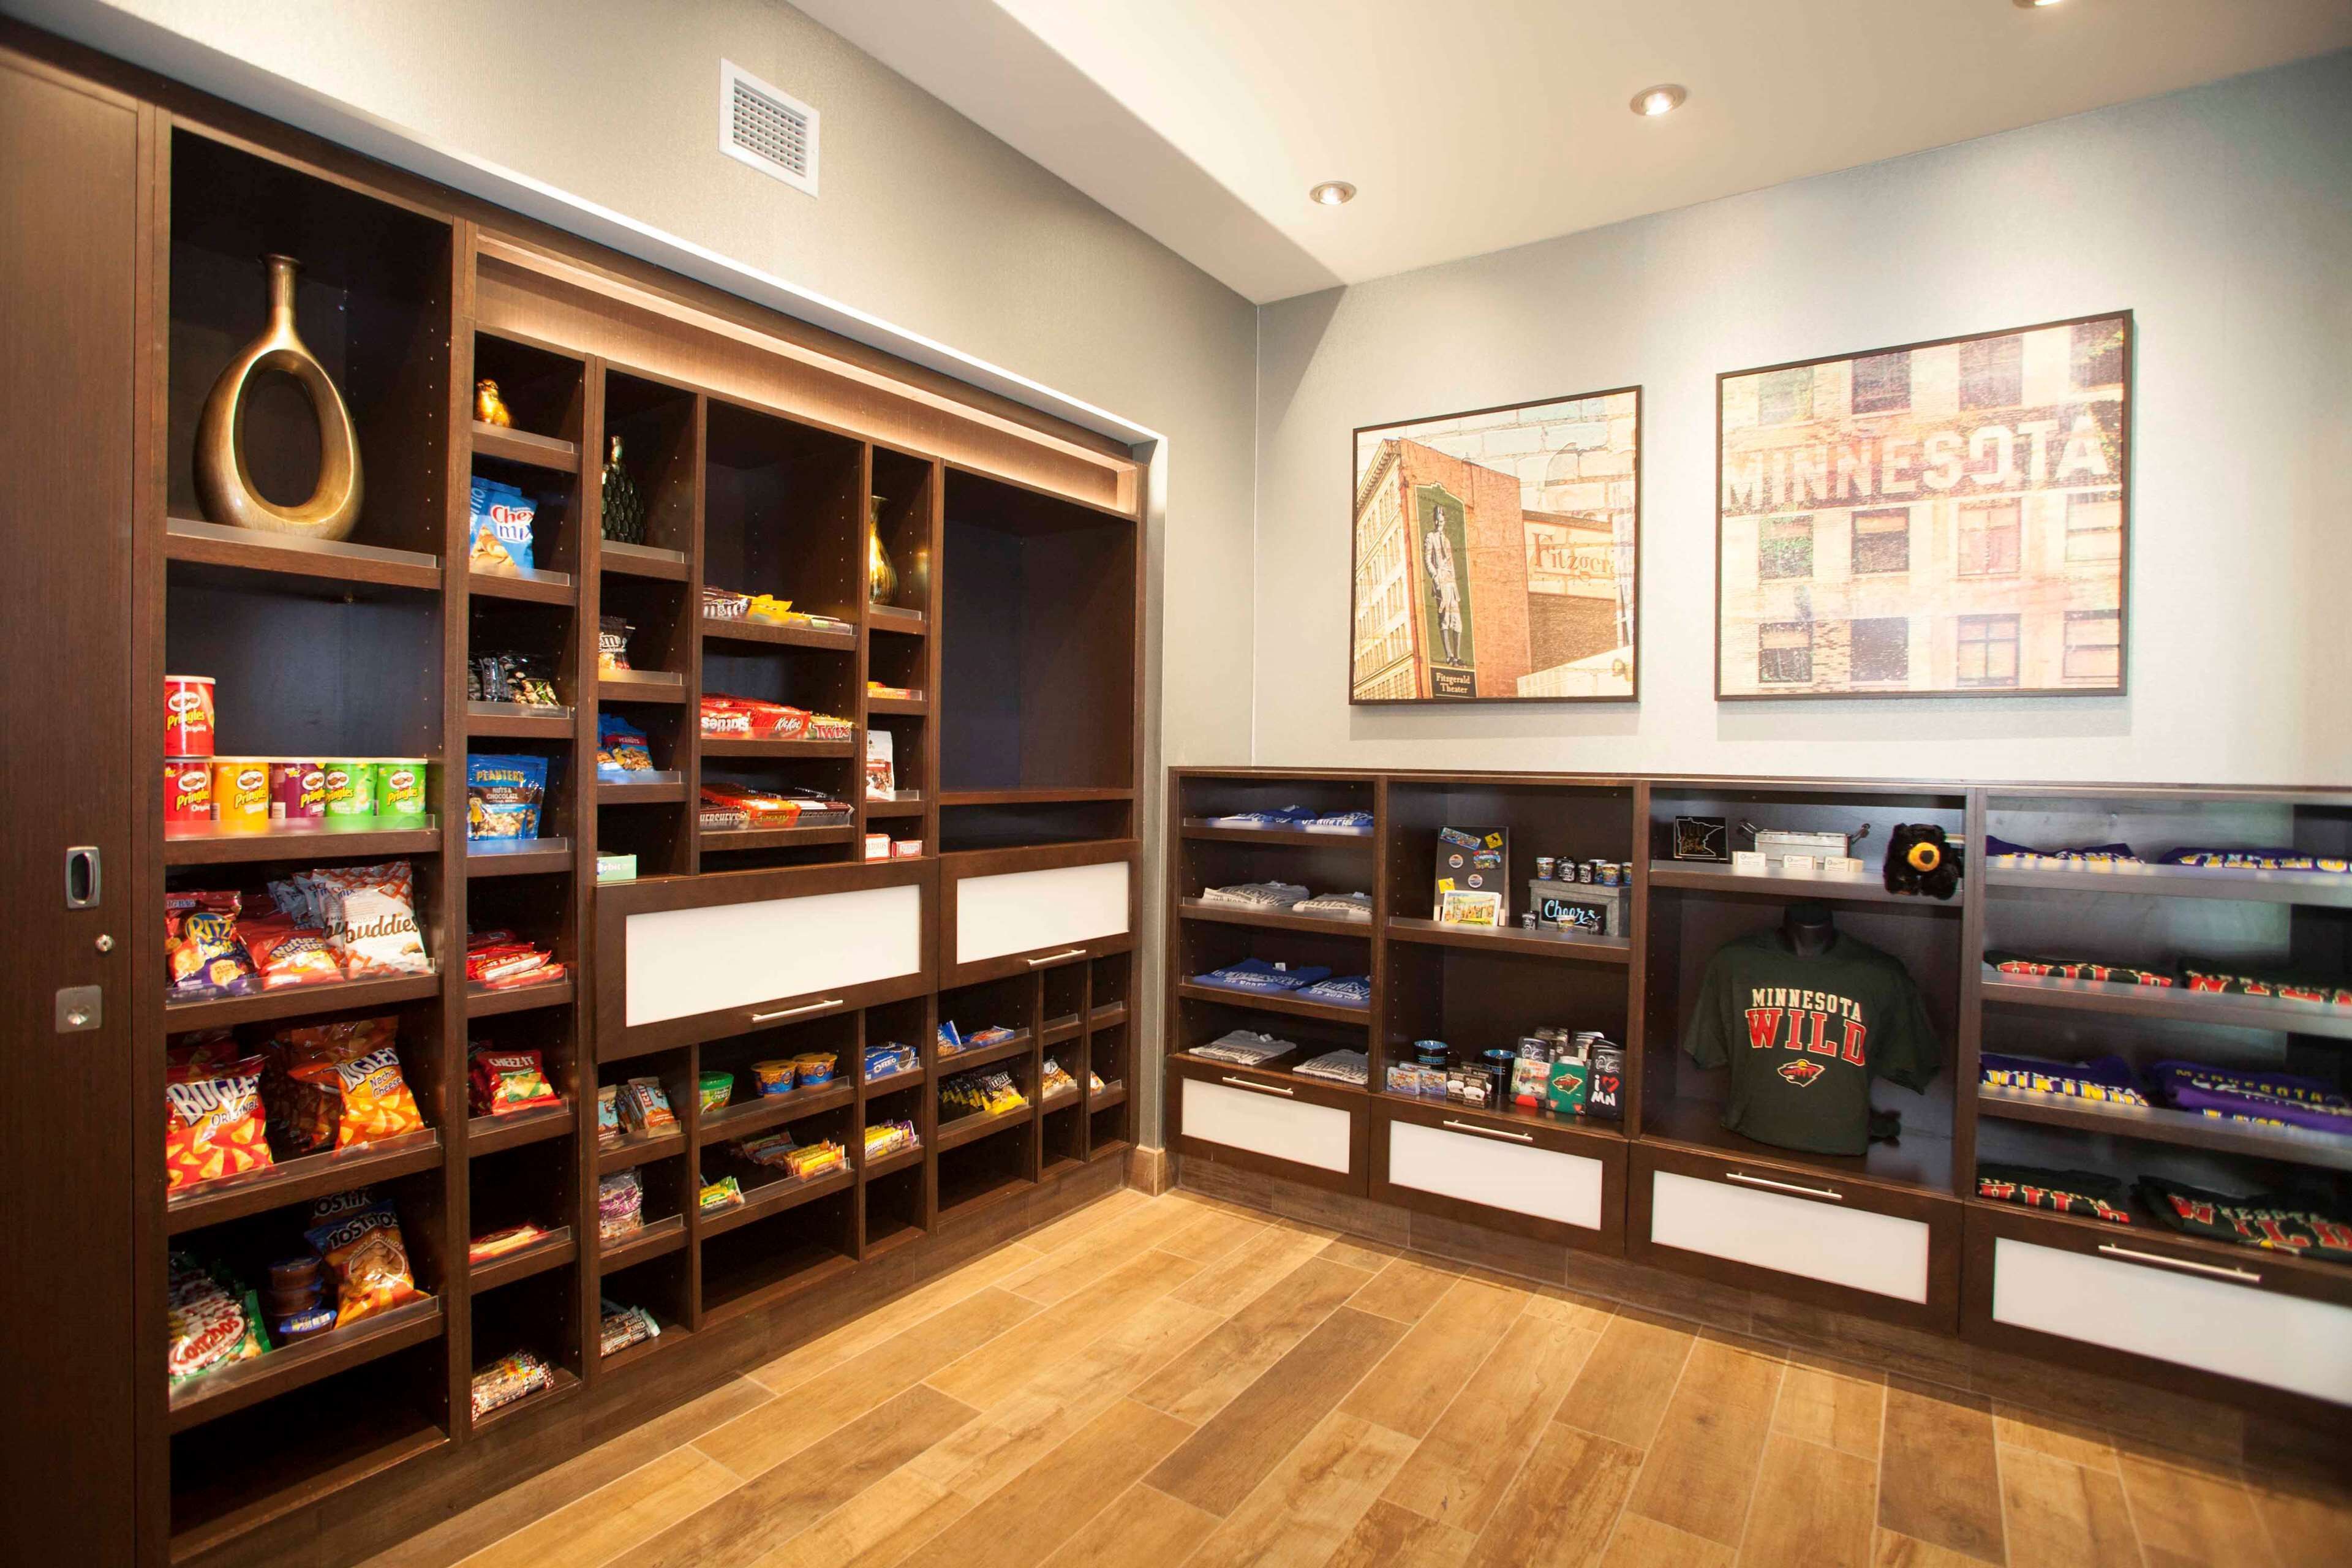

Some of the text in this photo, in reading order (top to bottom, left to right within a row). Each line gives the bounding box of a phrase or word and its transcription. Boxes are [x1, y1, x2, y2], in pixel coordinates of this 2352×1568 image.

[492, 505, 534, 524] Chex
[499, 525, 532, 540] mix
[1436, 673, 1471, 685] Fitzgerald
[1440, 682, 1468, 693] Theater
[476, 769, 525, 783] PLANTERS
[387, 786, 418, 807] Pringles
[186, 918, 232, 946] RITZ
[345, 913, 418, 944] buddies
[271, 937, 315, 957] Nutter
[1752, 988, 1862, 1023] MINNESOTA
[1744, 1008, 1867, 1066] WILD
[873, 1057, 897, 1073] OREO
[369, 1069, 395, 1089] Nacho
[372, 1076, 402, 1099] Cheese
[1591, 1091, 1616, 1107] MN
